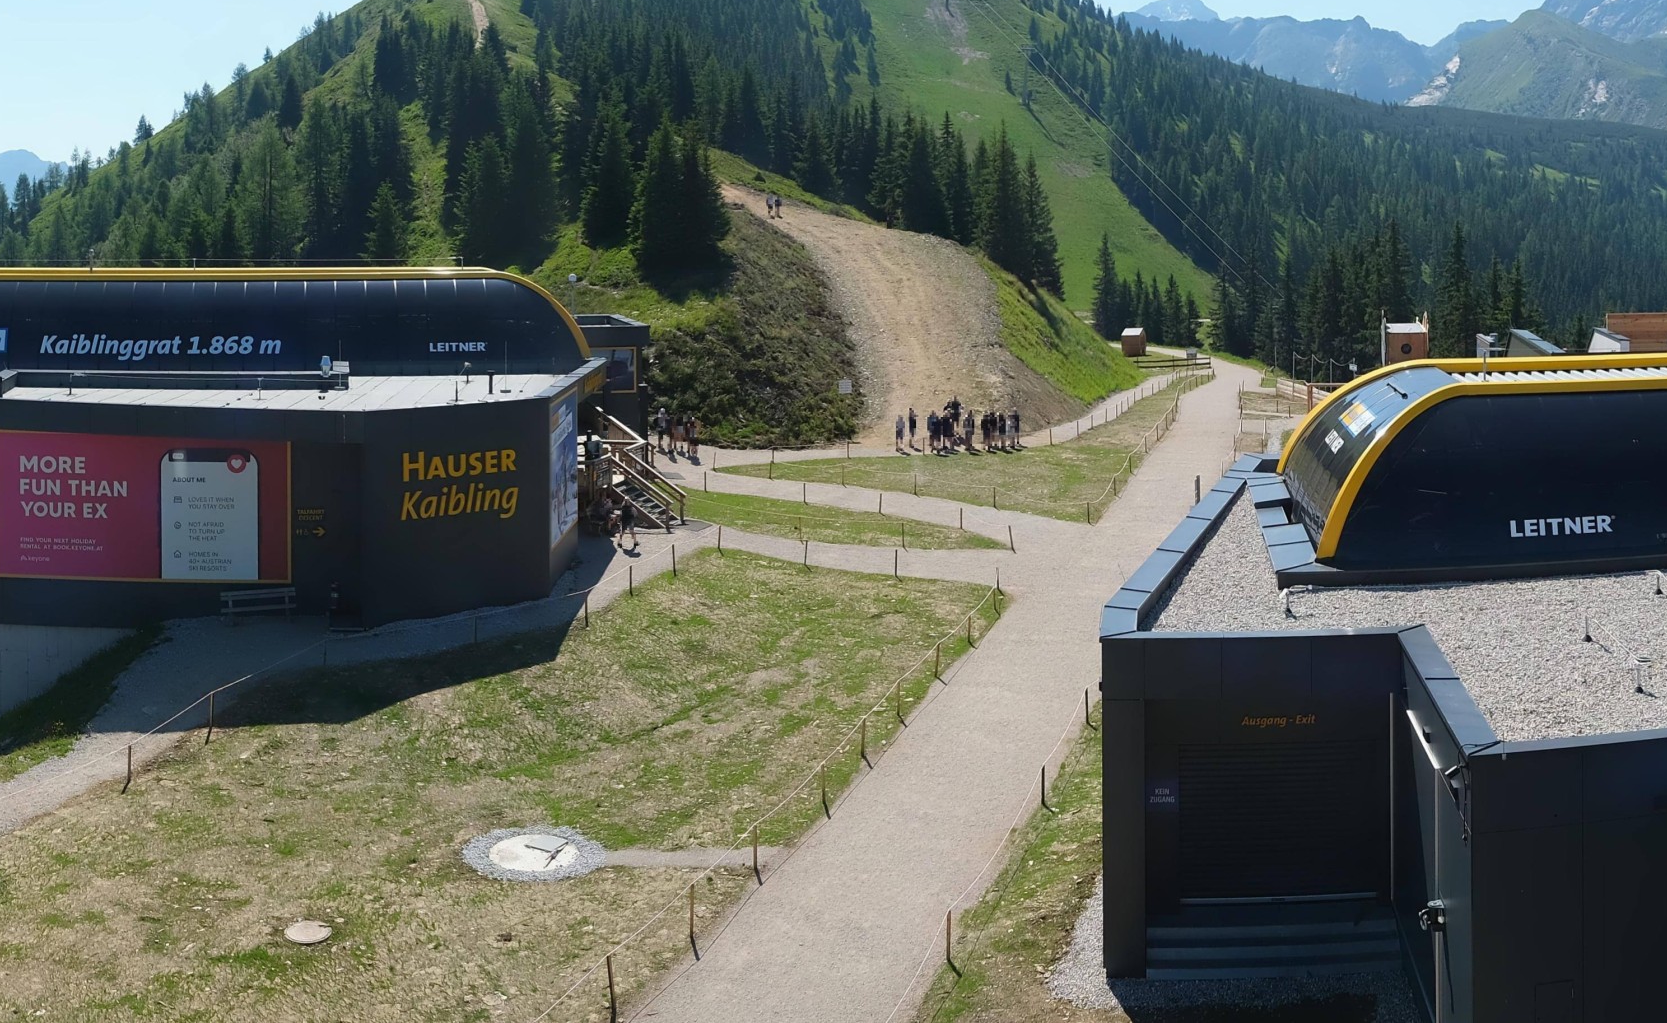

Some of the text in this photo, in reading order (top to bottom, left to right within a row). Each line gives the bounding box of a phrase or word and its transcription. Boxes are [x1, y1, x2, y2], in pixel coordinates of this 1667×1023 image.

[40, 334, 282, 361] Kaiblinggrat 1.868 m
[429, 342, 486, 352] LEITNER
[20, 456, 86, 474] MORE
[402, 449, 517, 481] HAUSER
[20, 479, 128, 497] FUN THAN
[21, 501, 108, 518] YOUR EX
[400, 483, 519, 521] Kaibling
[1509, 515, 1613, 538] LEITNER
[1241, 715, 1287, 728] Ausgang
[1295, 714, 1316, 725] Exit
